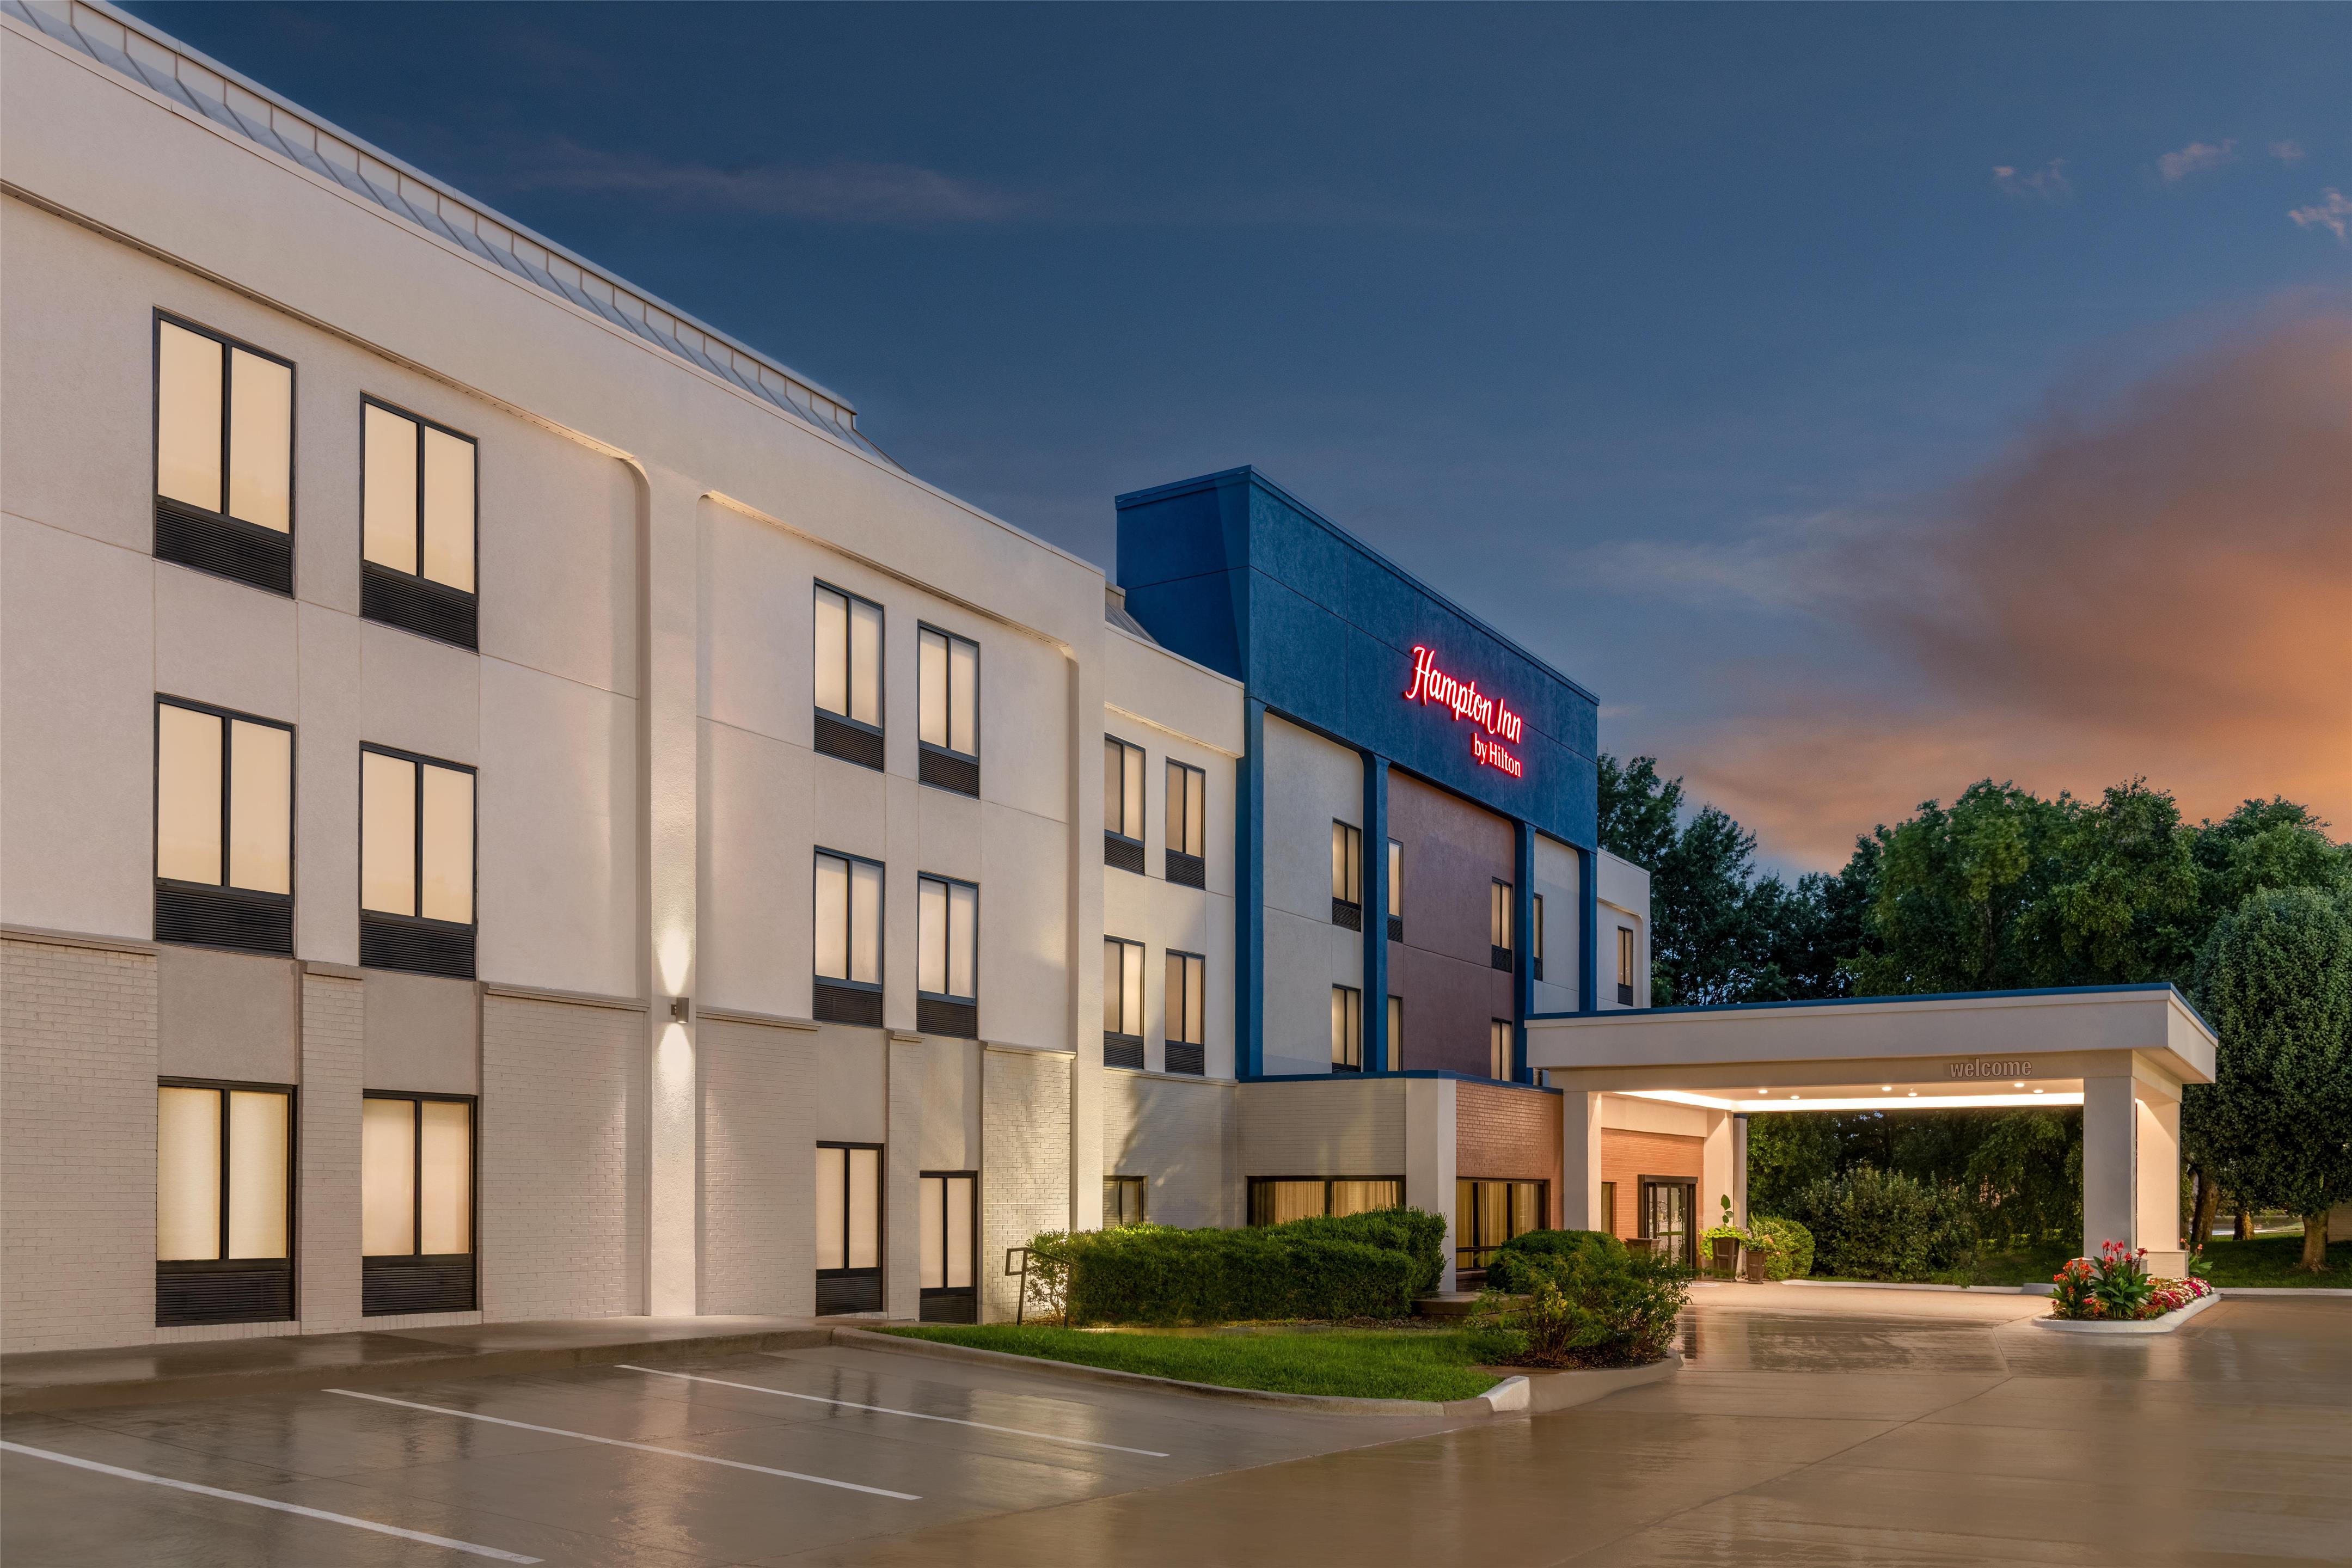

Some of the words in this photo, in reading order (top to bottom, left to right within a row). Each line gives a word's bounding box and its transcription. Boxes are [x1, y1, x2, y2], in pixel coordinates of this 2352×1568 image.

[1405, 646, 1495, 734] Hampton
[1497, 698, 1521, 744] Inn
[1474, 733, 1487, 764] by
[1489, 741, 1521, 777] Hilton
[1950, 1058, 2032, 1077] welcome
